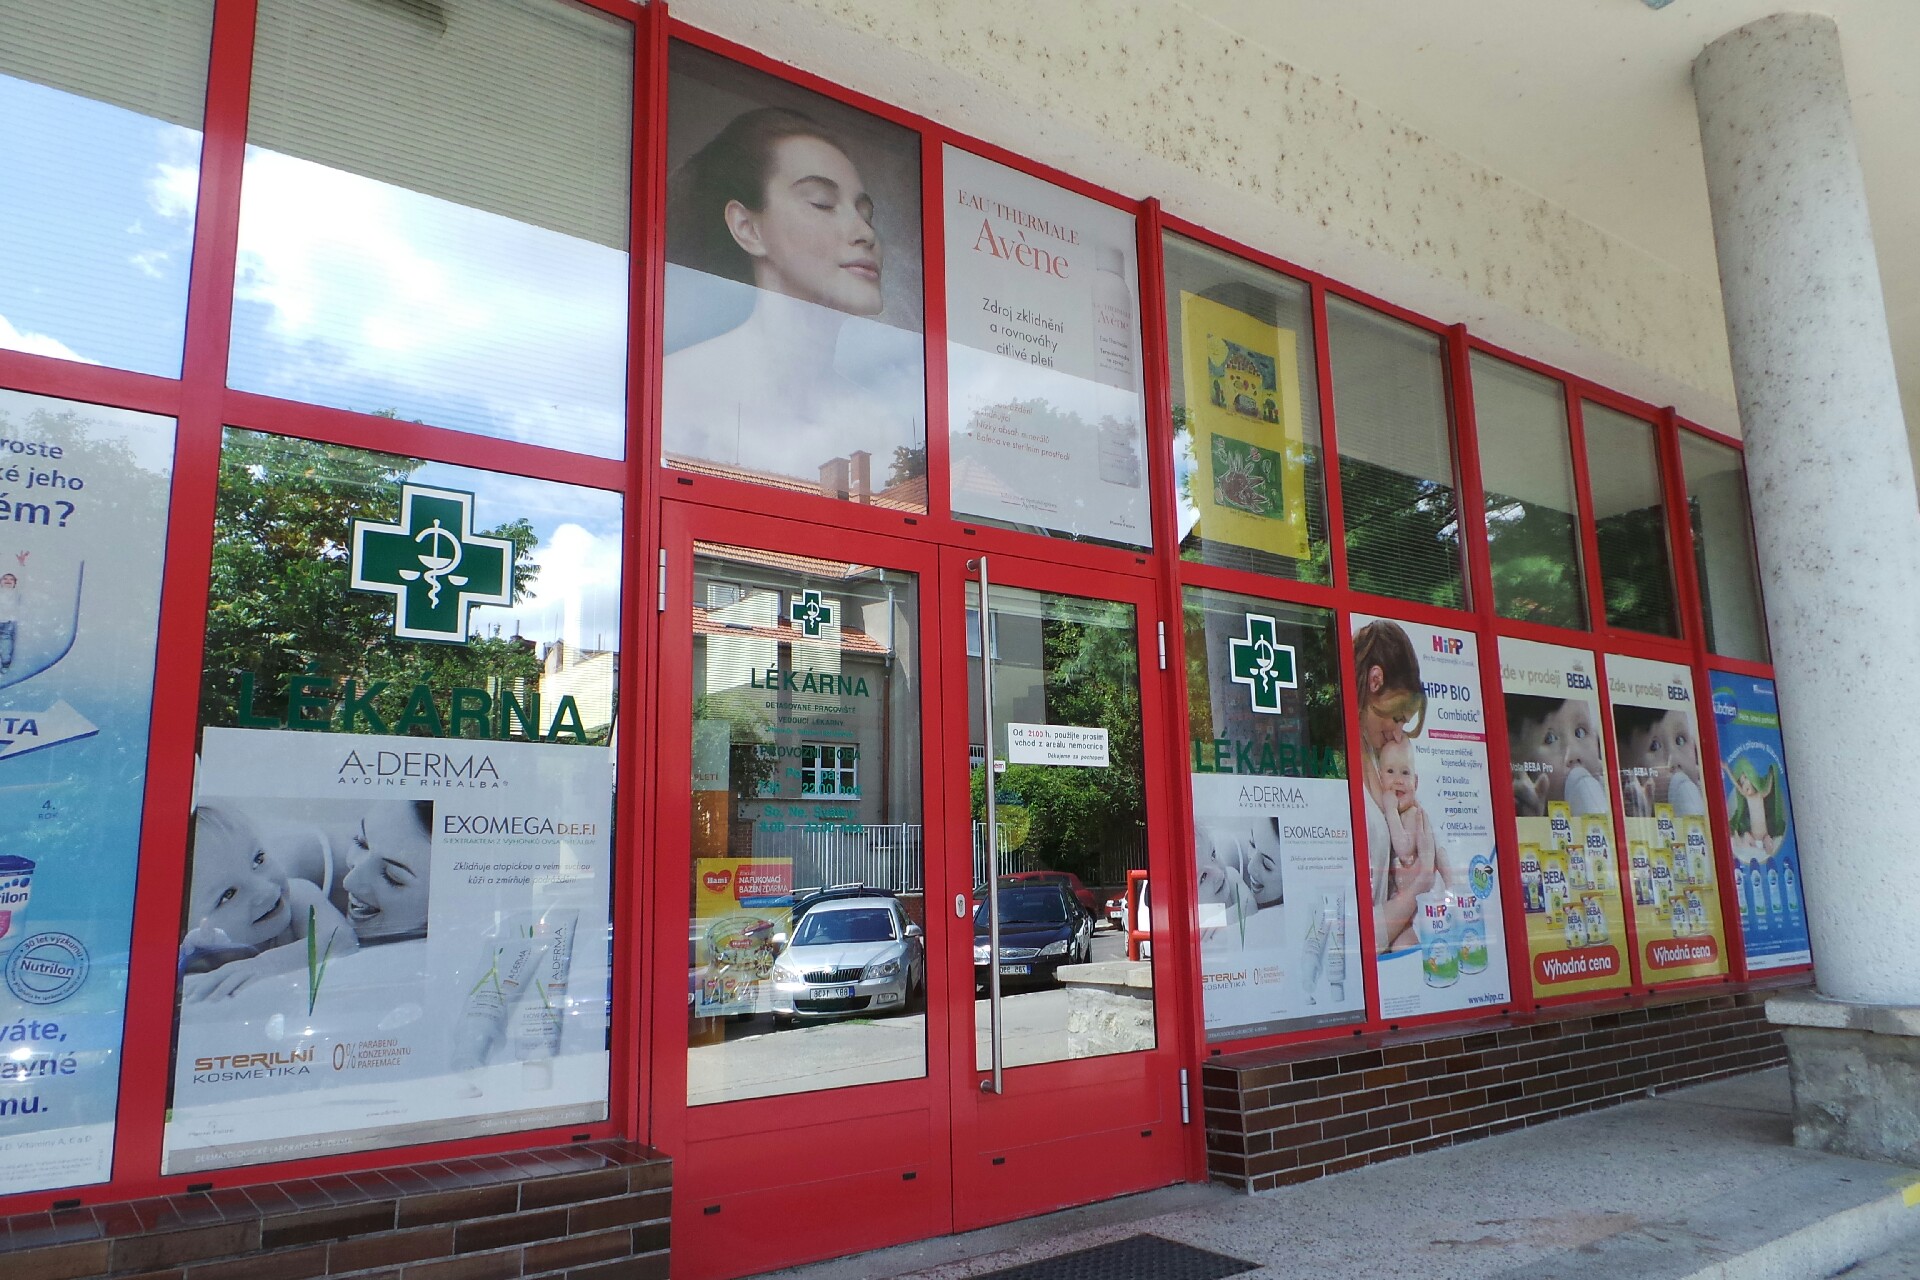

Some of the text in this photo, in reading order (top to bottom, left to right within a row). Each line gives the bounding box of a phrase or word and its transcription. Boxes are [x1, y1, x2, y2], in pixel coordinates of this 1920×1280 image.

[958, 189, 1080, 246] EAU THERMALE
[972, 218, 1069, 279] Avène
[982, 297, 1064, 334] Zdroj zklidnění
[990, 323, 1058, 353] a rovnováhy
[996, 343, 1053, 368] citlivé pleti
[25, 467, 84, 490] jeho
[1432, 635, 1464, 655] HiPP
[751, 663, 870, 697] LÉKÁRNA
[1500, 664, 1516, 680] de
[1518, 670, 1525, 679] v
[1527, 668, 1560, 688] prodeji
[1566, 673, 1593, 690] BEBA
[1422, 681, 1470, 702] HiPP BIO
[1667, 685, 1690, 702] BEBA
[238, 662, 588, 743] LÉKÁRNA
[0, 717, 39, 736] TA
[1012, 728, 1023, 737] Od
[1054, 731, 1080, 741] použijte
[1014, 739, 1036, 747] vchod
[1045, 740, 1066, 749] areálu
[1193, 729, 1340, 778] LÉKÁRNA
[338, 749, 500, 780] A-DERMA
[1523, 761, 1554, 773] BEBA Pro
[338, 777, 408, 786] AVOINE
[1239, 785, 1304, 804] A-DERMA
[444, 815, 555, 835] EXOMEGA
[1550, 819, 1571, 831] BEBA
[1657, 819, 1674, 831] BEBA
[1283, 826, 1331, 839] EXOMEGA
[1586, 835, 1608, 848] BEBA
[1687, 834, 1706, 846] BEBA
[453, 861, 491, 873] Zklidňuje
[493, 861, 533, 872] atopickou
[1520, 861, 1541, 873] BEBA
[1571, 856, 1584, 864] BEBA
[468, 874, 485, 885] kůži
[739, 874, 782, 884] NAFUKOVACÍ
[1543, 871, 1566, 885] BEBA
[1652, 866, 1671, 879] BEBA
[707, 876, 728, 884] Hami
[0, 891, 29, 904] ilon
[1457, 896, 1477, 908] HiPP
[1425, 904, 1447, 917] HiPP
[1586, 907, 1602, 916] BEBA
[1432, 920, 1444, 929] BIO
[1567, 915, 1582, 924] BEBA
[23, 939, 36, 950] 30
[551, 927, 564, 981] A-DERMA
[1653, 944, 1711, 966] Výhodná cena
[20, 959, 75, 976] Nutrilon
[1542, 955, 1611, 981] Výhodná cena
[192, 1065, 311, 1084] KOSMETIKA
